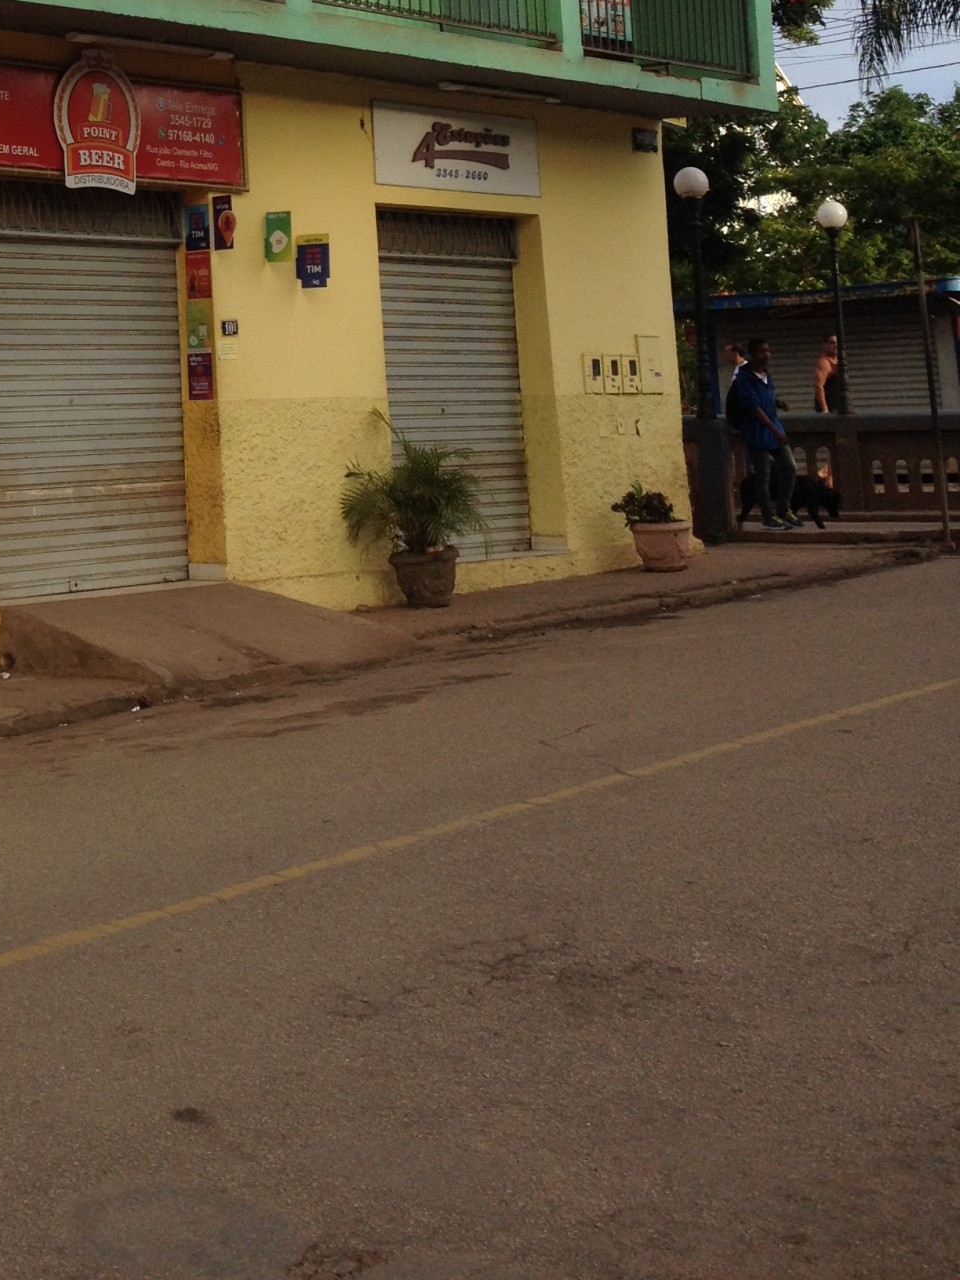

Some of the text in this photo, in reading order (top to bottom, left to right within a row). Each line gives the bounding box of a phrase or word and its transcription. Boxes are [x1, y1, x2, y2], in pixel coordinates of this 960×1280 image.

[170, 114, 212, 129] 3545-1729
[83, 126, 118, 141] POINT
[168, 129, 215, 144] 97168-4140
[11, 145, 39, 157] GERAL
[199, 149, 213, 158] Filho
[78, 149, 125, 171] BEER
[156, 158, 176, 168] Centro
[180, 160, 190, 168] Rio
[74, 174, 130, 190] DISTRIBUIDORA
[191, 230, 205, 239] TIM
[306, 265, 322, 274] TIM
